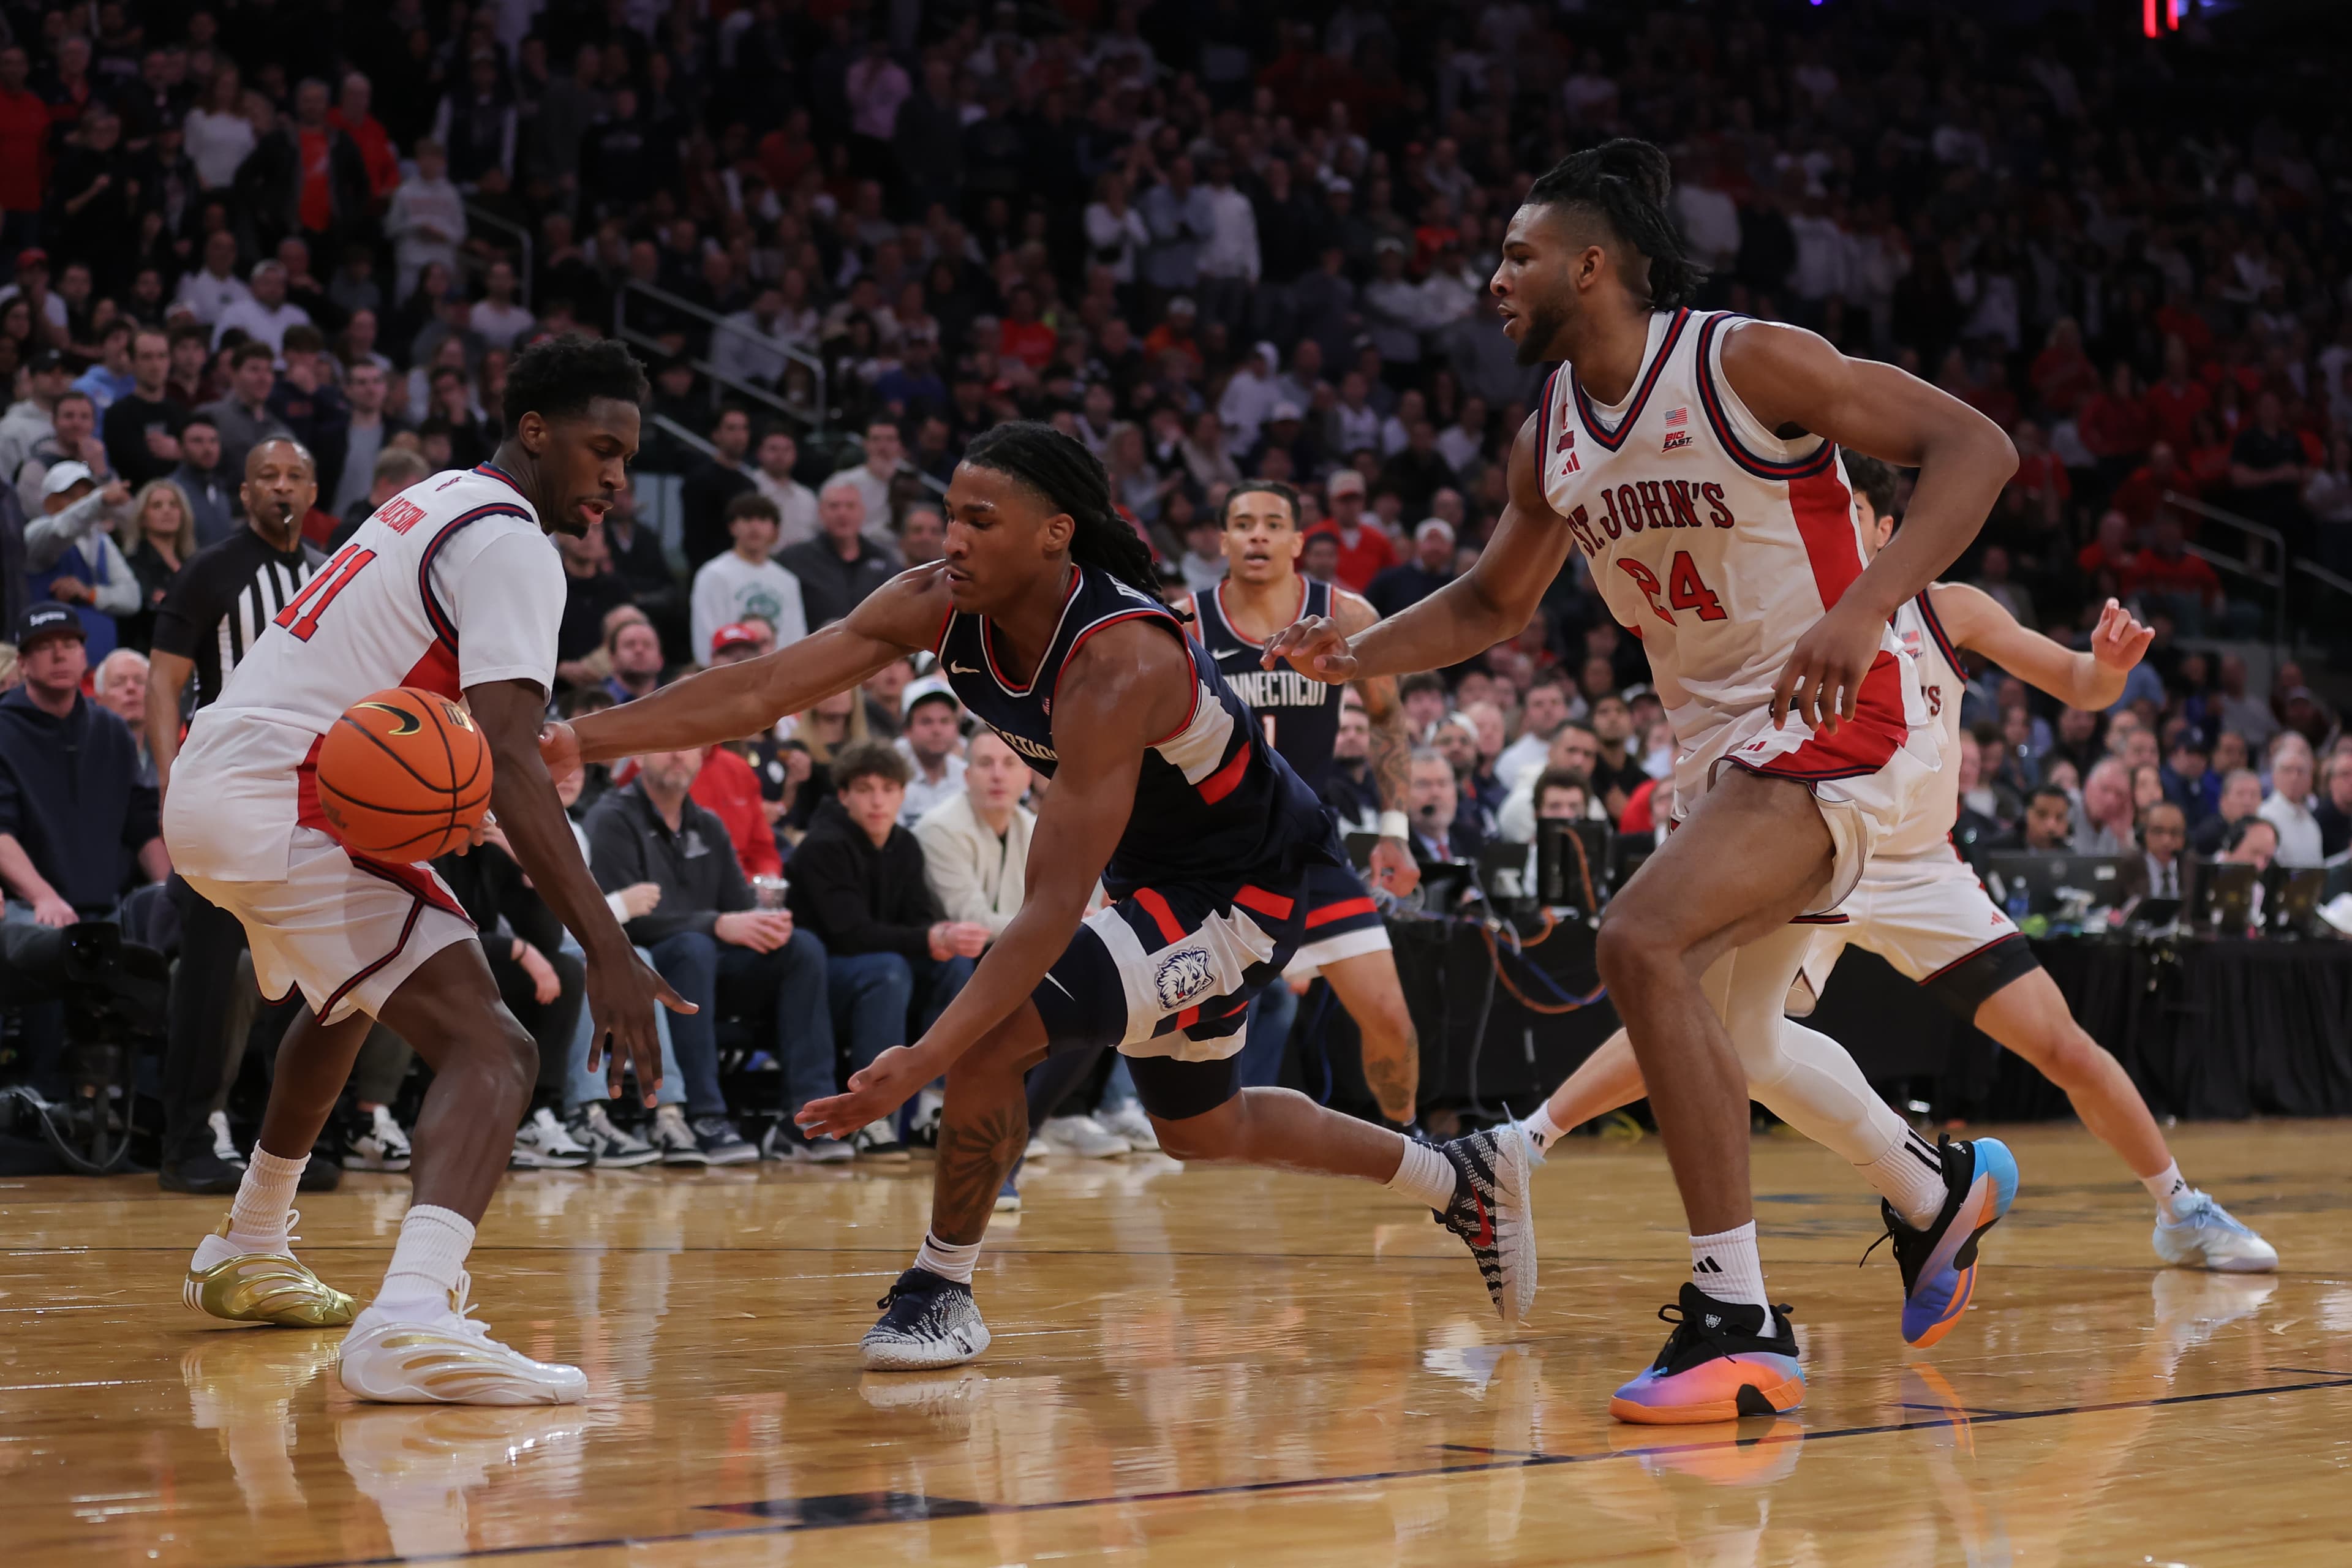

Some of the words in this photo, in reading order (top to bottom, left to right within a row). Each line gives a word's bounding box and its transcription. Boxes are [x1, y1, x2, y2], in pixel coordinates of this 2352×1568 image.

[1662, 436, 1694, 449] EAST
[1665, 430, 1686, 442] BIG
[373, 496, 428, 537] JACKSON
[1600, 479, 1735, 540] JOHN'S
[273, 543, 377, 643] 11
[1616, 550, 1728, 627] 24
[1223, 669, 1328, 707] NNECTICUT
[1261, 713, 1277, 750] 1
